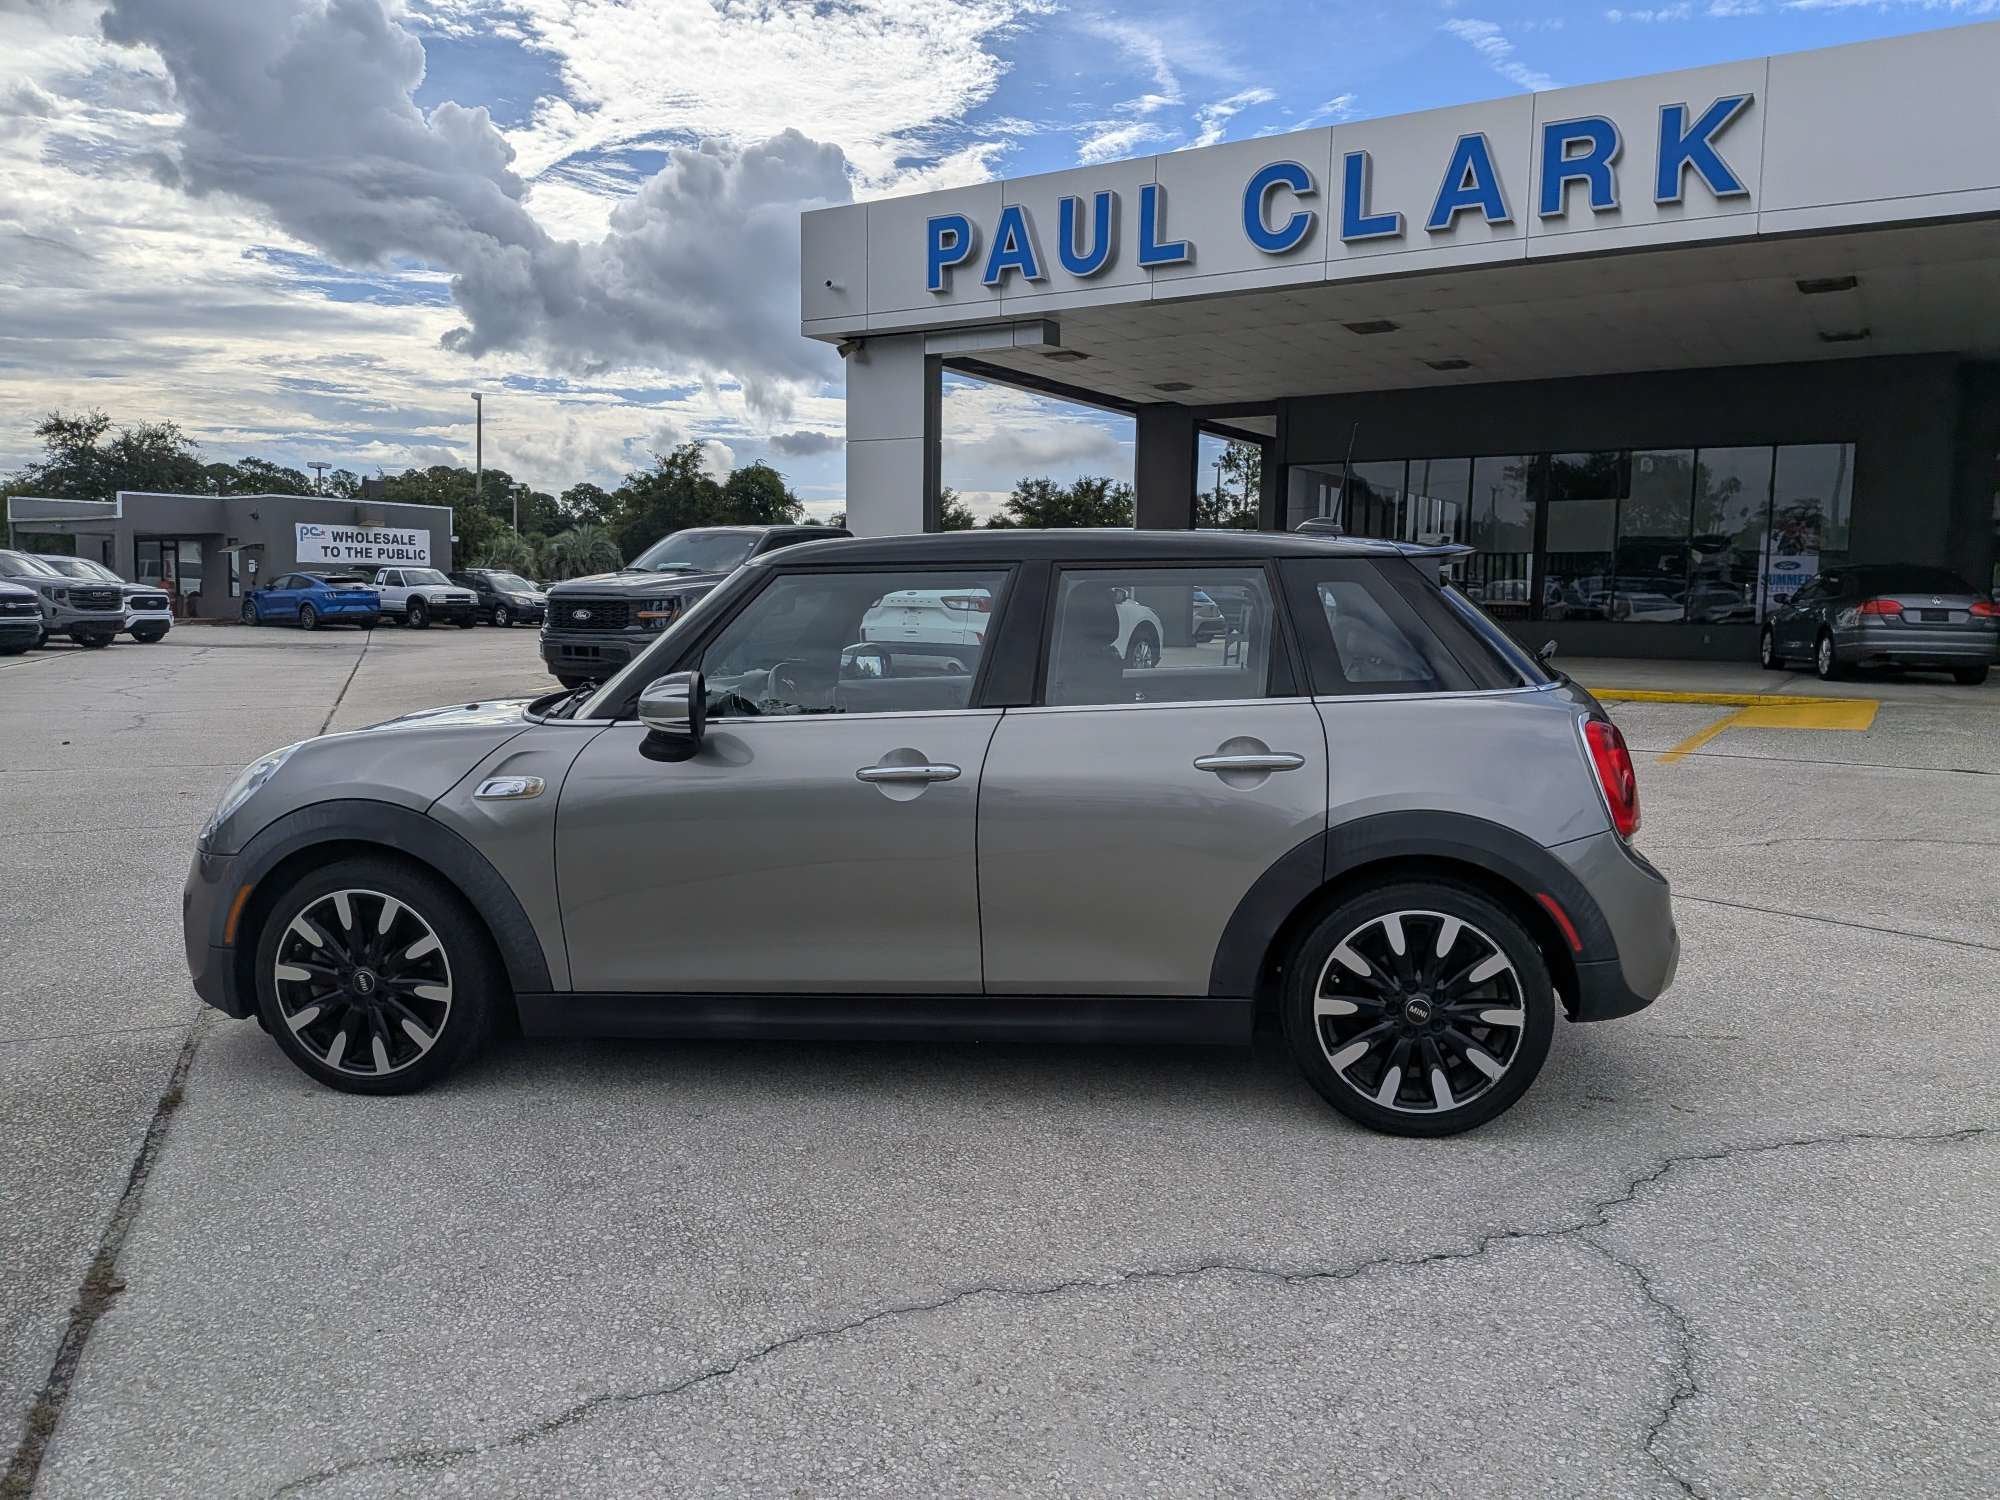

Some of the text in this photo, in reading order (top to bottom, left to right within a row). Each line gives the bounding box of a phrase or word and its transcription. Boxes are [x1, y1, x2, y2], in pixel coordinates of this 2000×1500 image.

[926, 93, 1755, 294] PAUL CLARK
[331, 530, 417, 546] WHOLESALE
[321, 545, 426, 561] TO THE PUBLIC
[1409, 1005, 1428, 1019] MINI
